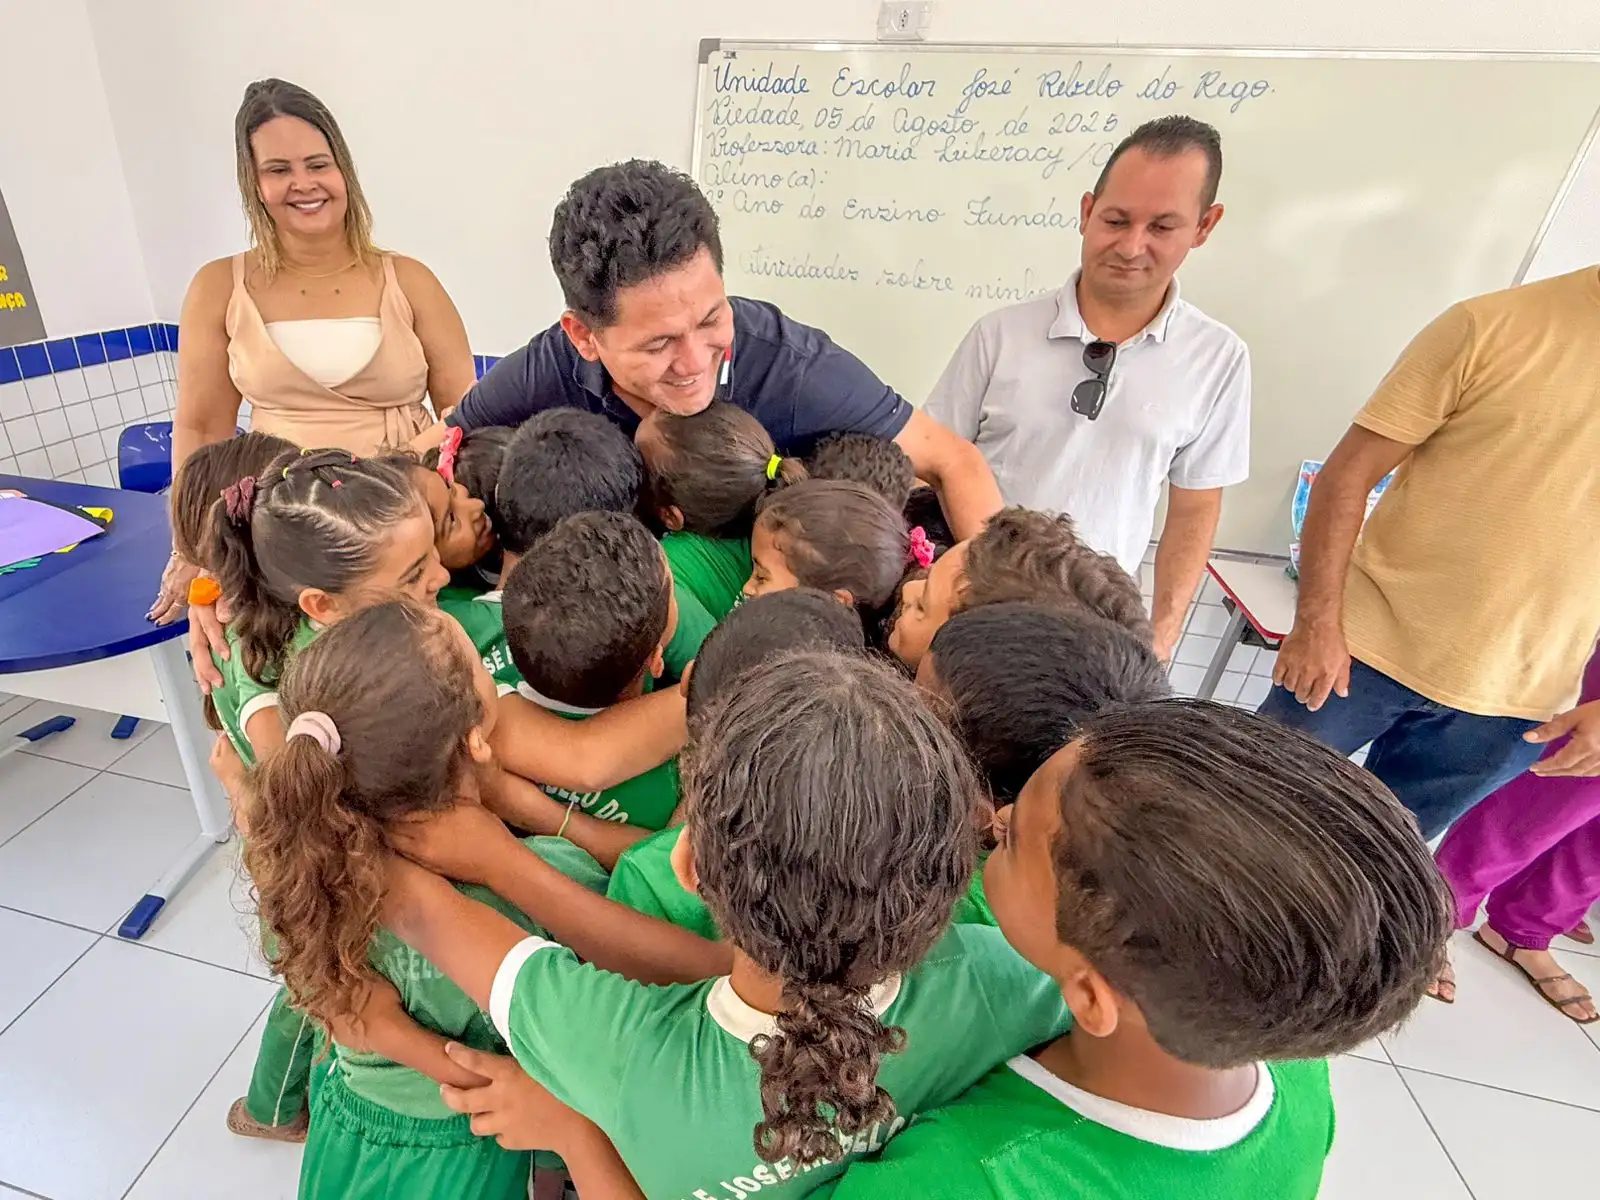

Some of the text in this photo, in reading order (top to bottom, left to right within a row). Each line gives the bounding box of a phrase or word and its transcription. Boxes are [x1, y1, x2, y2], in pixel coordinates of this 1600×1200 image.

[713, 61, 810, 94] Unidade
[832, 62, 937, 98] Escolar
[958, 67, 1020, 113] José
[1037, 60, 1124, 98] Rebelo
[1136, 64, 1184, 100] do
[813, 107, 844, 130] 05
[845, 102, 876, 132] de
[893, 107, 979, 147] Agosto
[995, 105, 1029, 136] de
[1048, 110, 1119, 135] 2025
[833, 135, 918, 160] Maria
[733, 188, 784, 214] Ano
[800, 193, 827, 219] do
[842, 197, 946, 222] Ensino
[739, 244, 1047, 300] Atividades sobre minh
